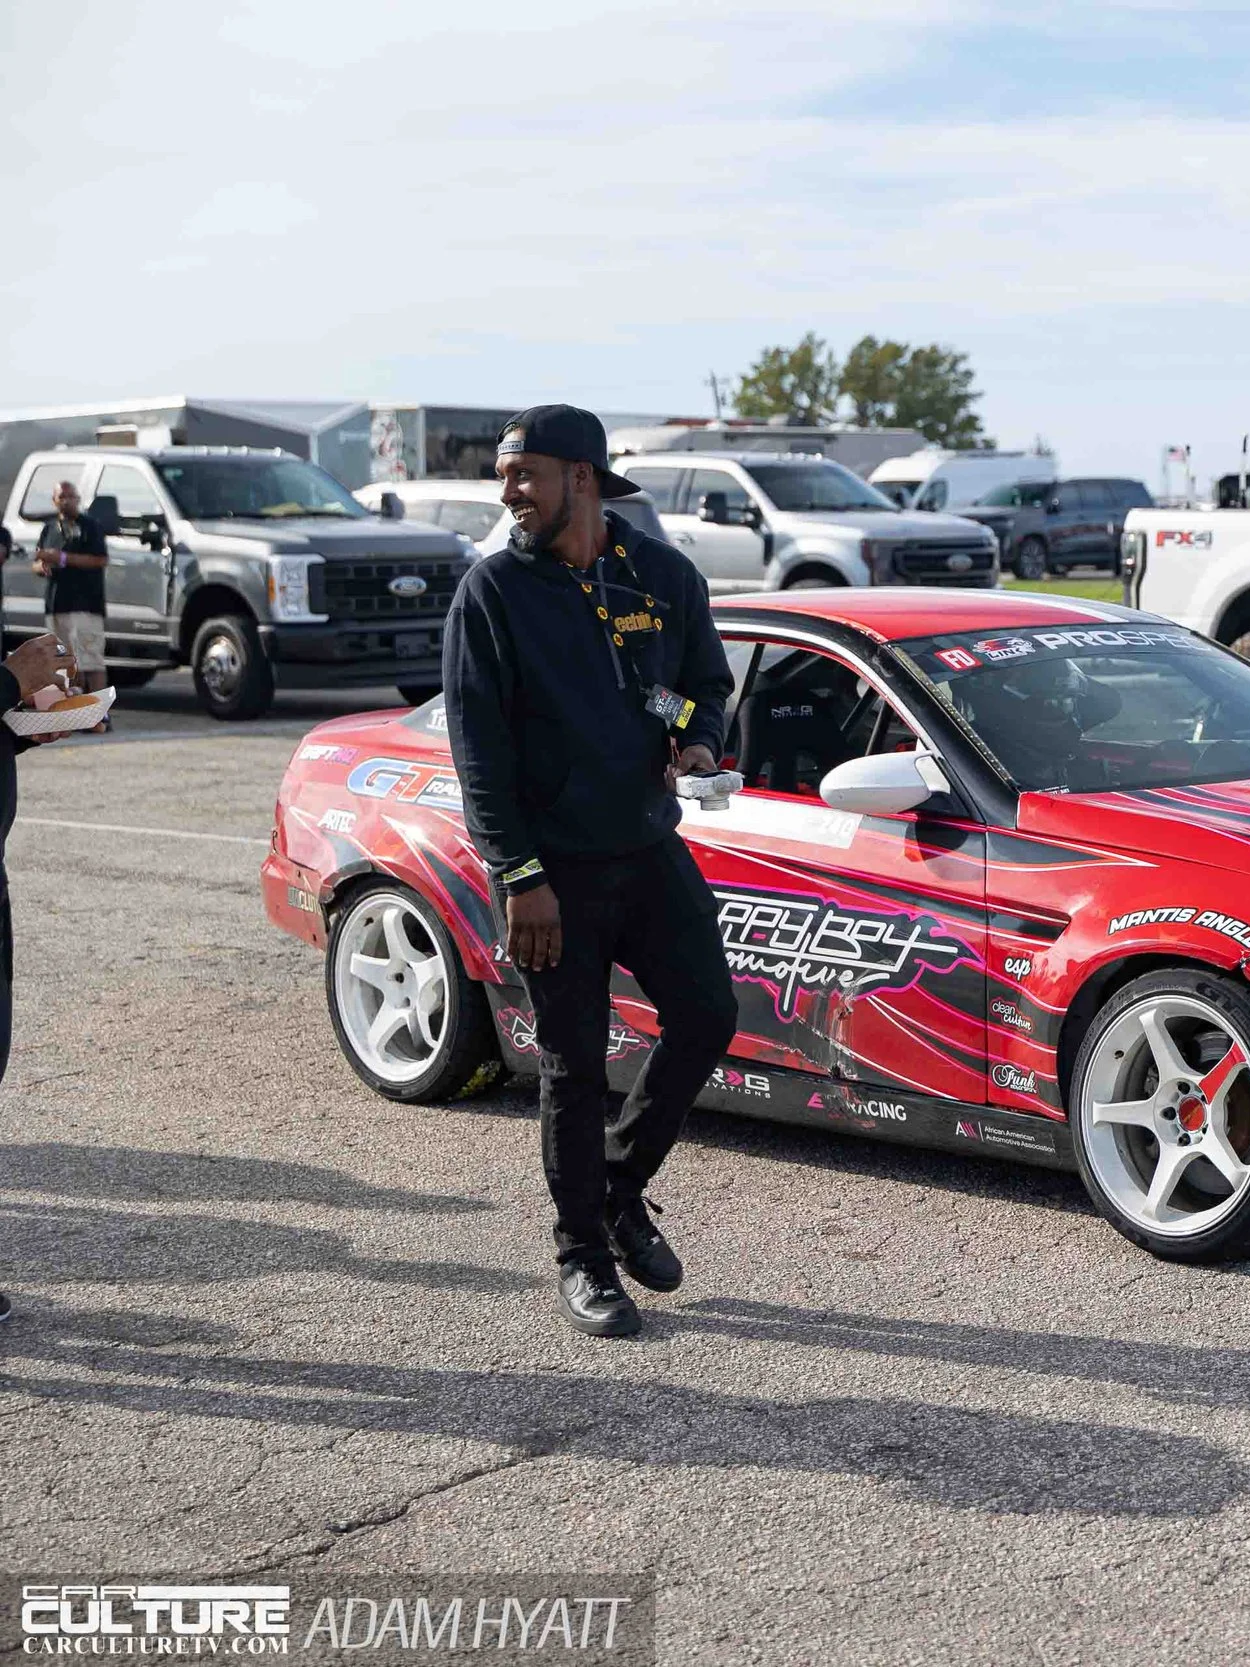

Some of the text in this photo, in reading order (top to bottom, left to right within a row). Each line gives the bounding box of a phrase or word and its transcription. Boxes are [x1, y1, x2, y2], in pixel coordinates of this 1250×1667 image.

[1156, 530, 1212, 548] FX4
[985, 646, 1032, 661] LINK
[346, 757, 434, 803] GT
[1108, 906, 1197, 935] MANTIS
[1004, 957, 1032, 981] esp
[992, 1000, 1016, 1016] clean
[711, 1067, 770, 1092] RG
[992, 1064, 1036, 1087] Funk
